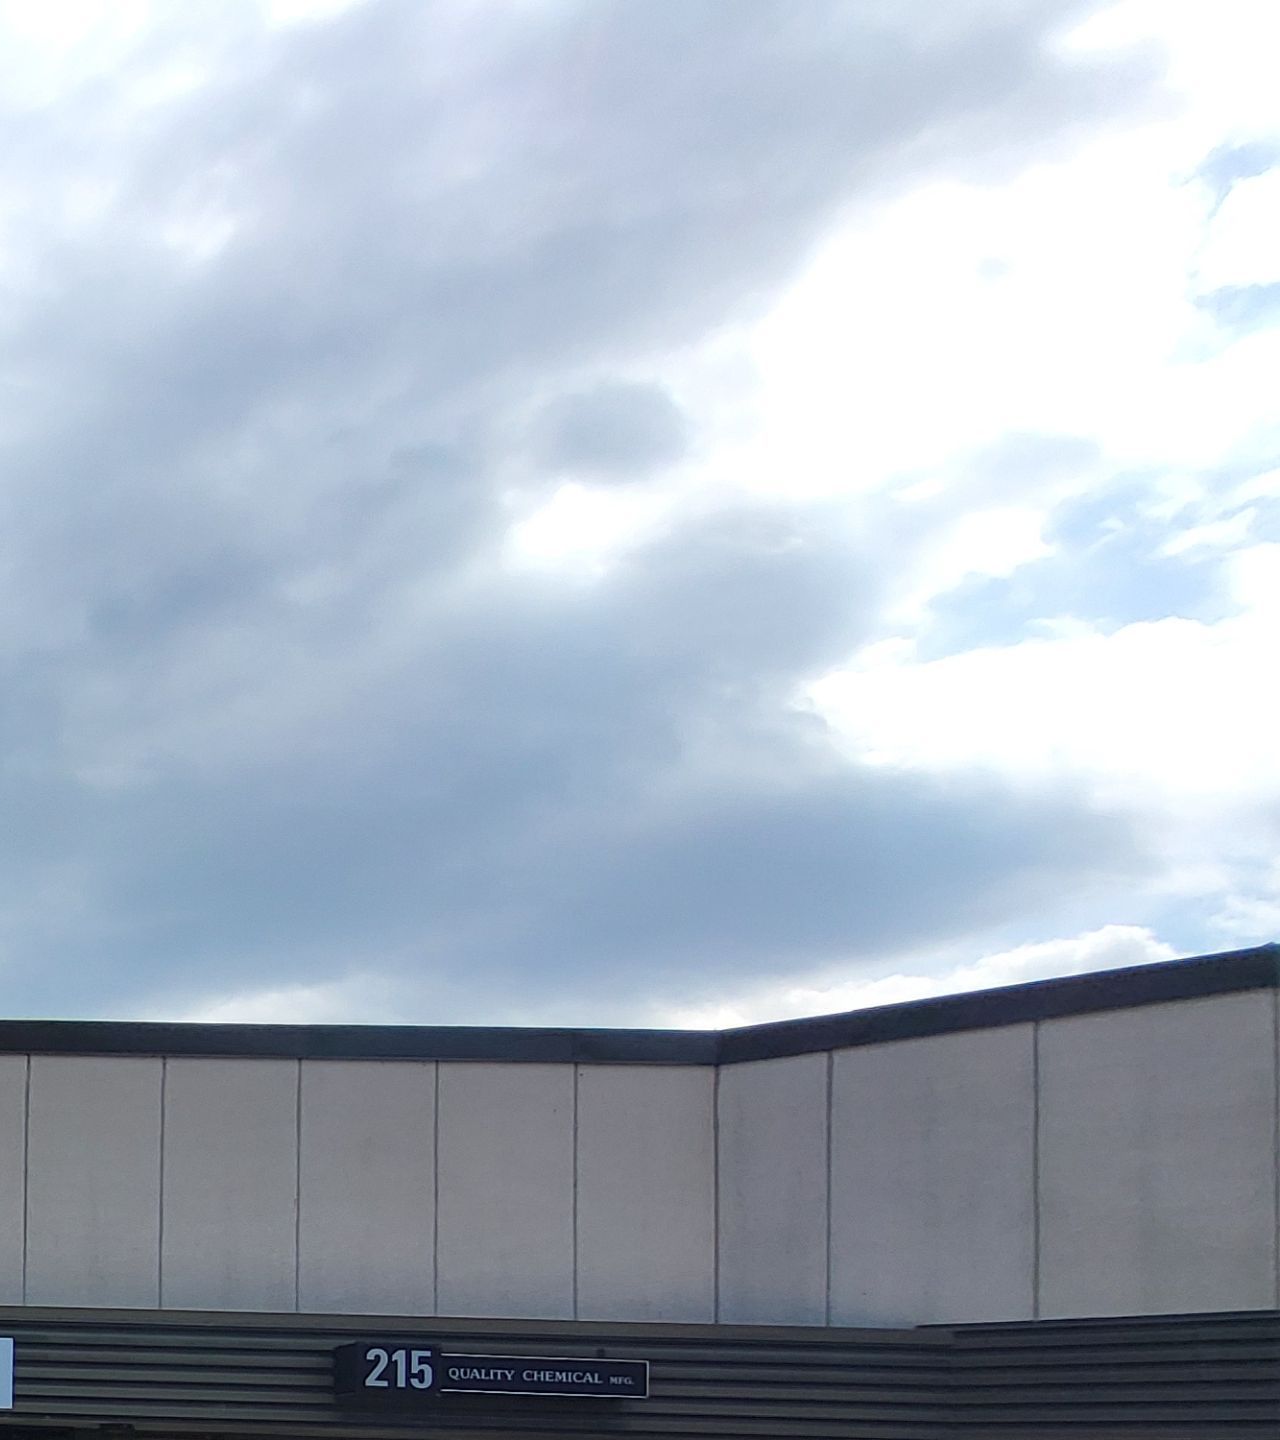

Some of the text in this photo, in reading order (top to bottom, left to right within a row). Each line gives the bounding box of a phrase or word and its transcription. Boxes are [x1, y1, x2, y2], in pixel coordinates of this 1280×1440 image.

[364, 1348, 433, 1389] 215
[448, 1368, 515, 1381] QUALITY
[522, 1369, 603, 1384] CHEMICAL
